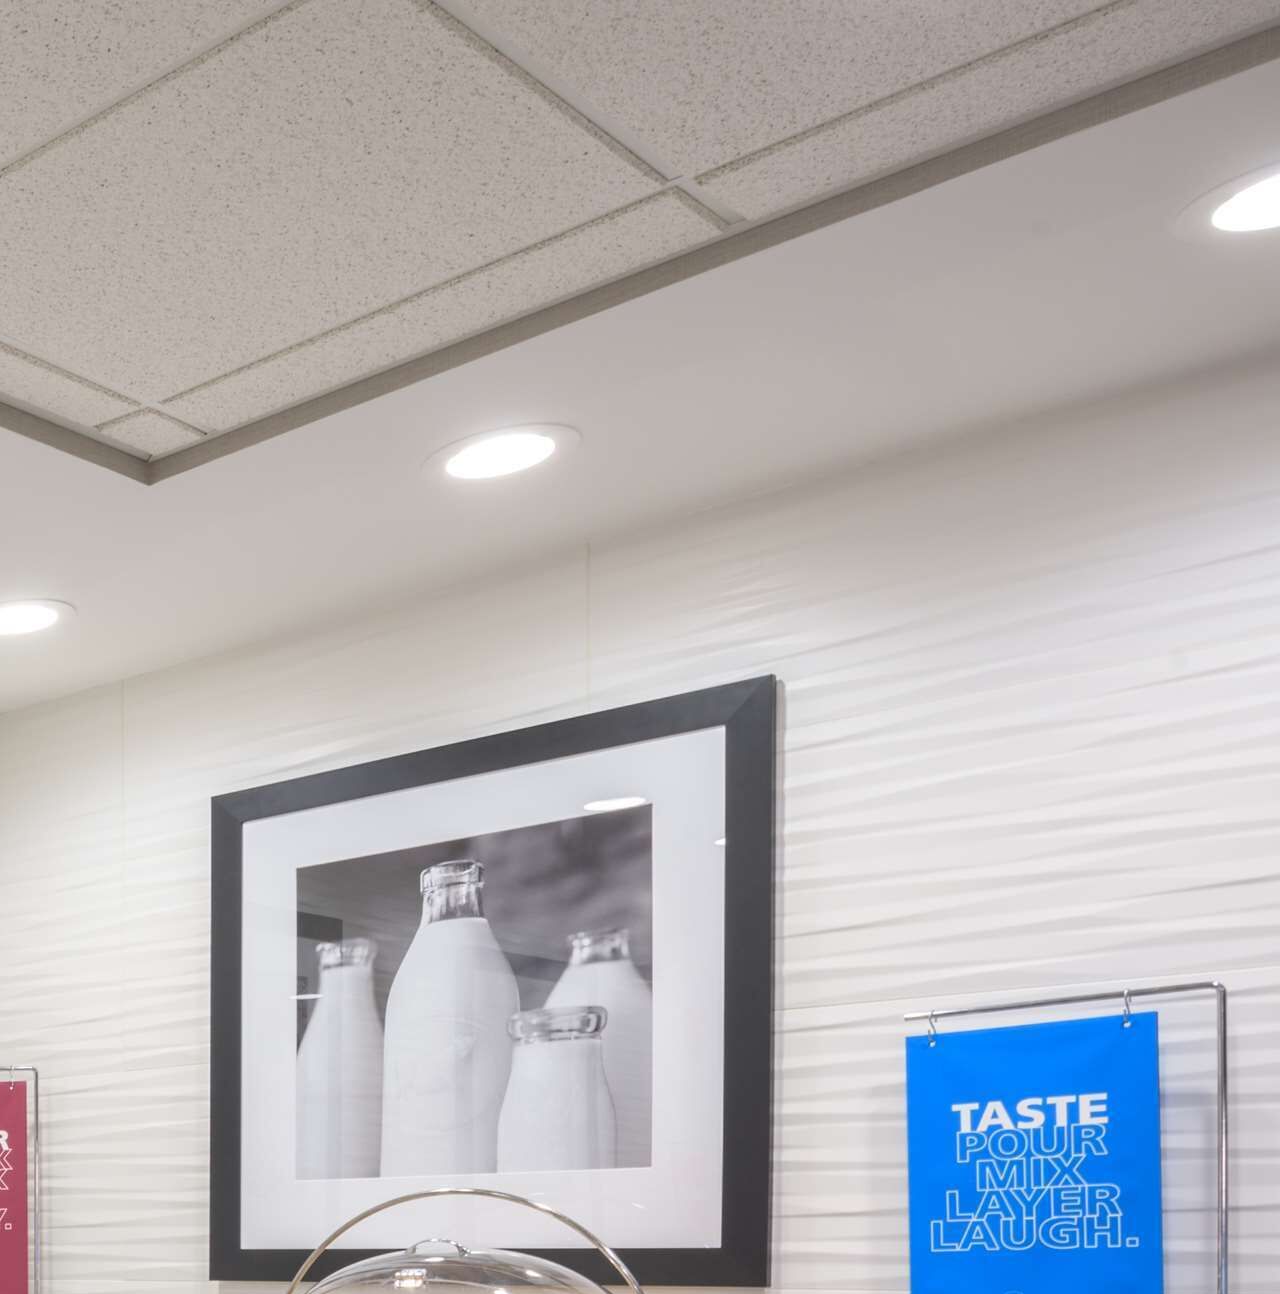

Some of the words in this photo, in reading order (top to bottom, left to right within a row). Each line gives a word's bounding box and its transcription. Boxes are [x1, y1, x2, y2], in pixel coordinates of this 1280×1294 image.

[951, 1092, 1110, 1133] TASTE
[955, 1123, 1109, 1164] POUR
[975, 1153, 1090, 1193] MIX
[945, 1183, 1124, 1223] LAYER
[930, 1214, 1140, 1253] LAUGH.
